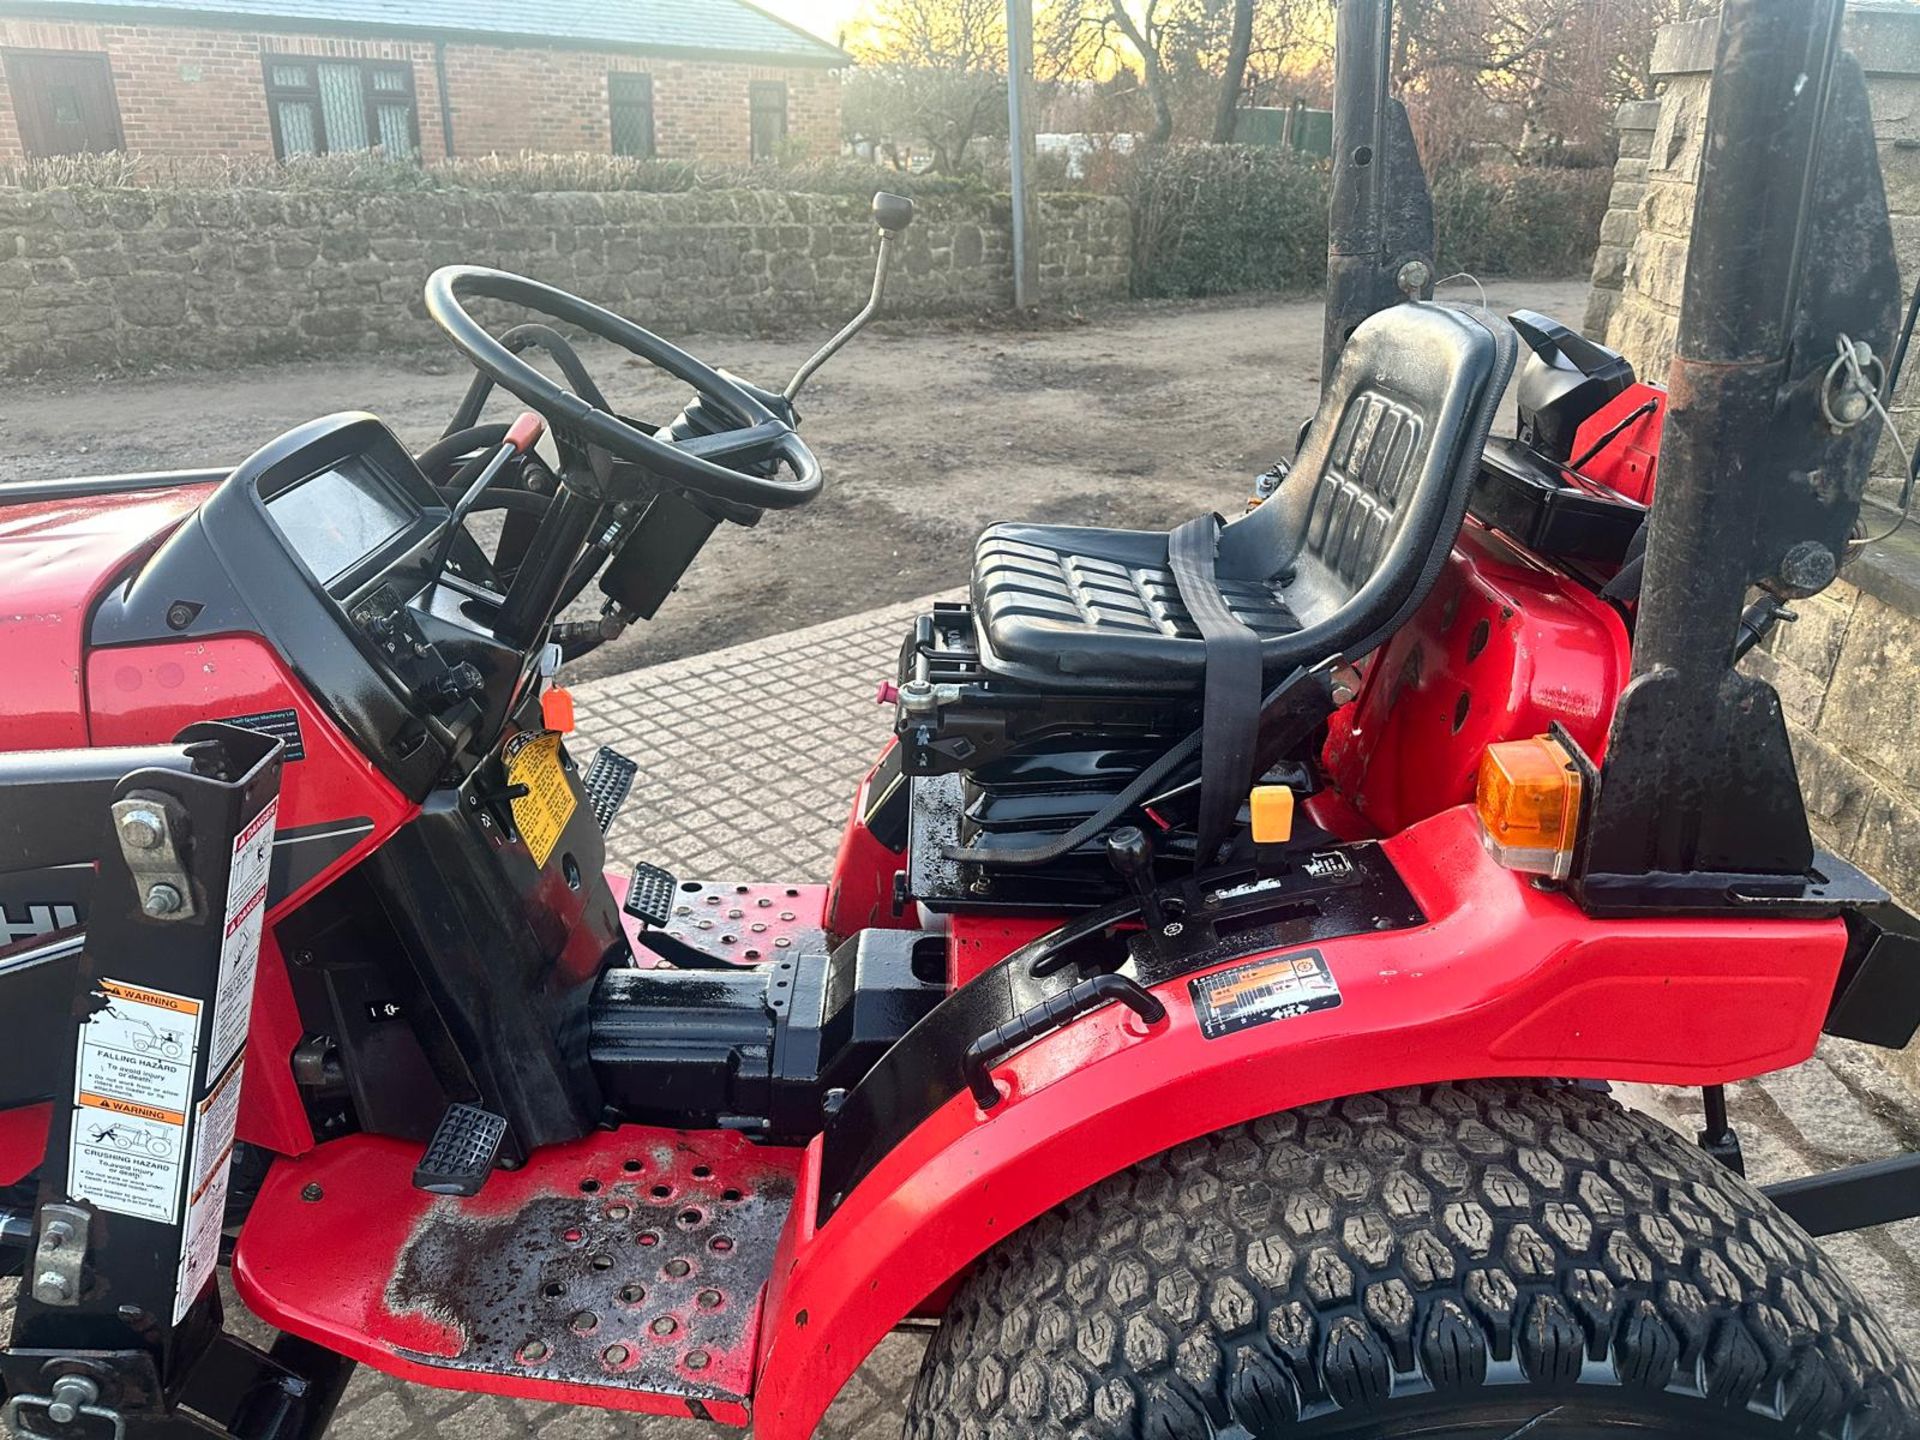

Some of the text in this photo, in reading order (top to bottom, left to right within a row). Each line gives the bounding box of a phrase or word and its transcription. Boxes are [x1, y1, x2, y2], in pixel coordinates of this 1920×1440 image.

[247, 804, 275, 841] DANGER
[236, 888, 265, 926] DANGER
[124, 990, 178, 1009] WARNING
[97, 1050, 177, 1073] FALLING HAZARD
[119, 1067, 141, 1075] avoid
[143, 1071, 165, 1081] injury
[113, 1102, 165, 1119] WARNING
[84, 1148, 170, 1172] CRUSHING HAZARD
[109, 1163, 132, 1171] avoid
[133, 1167, 154, 1177] injury
